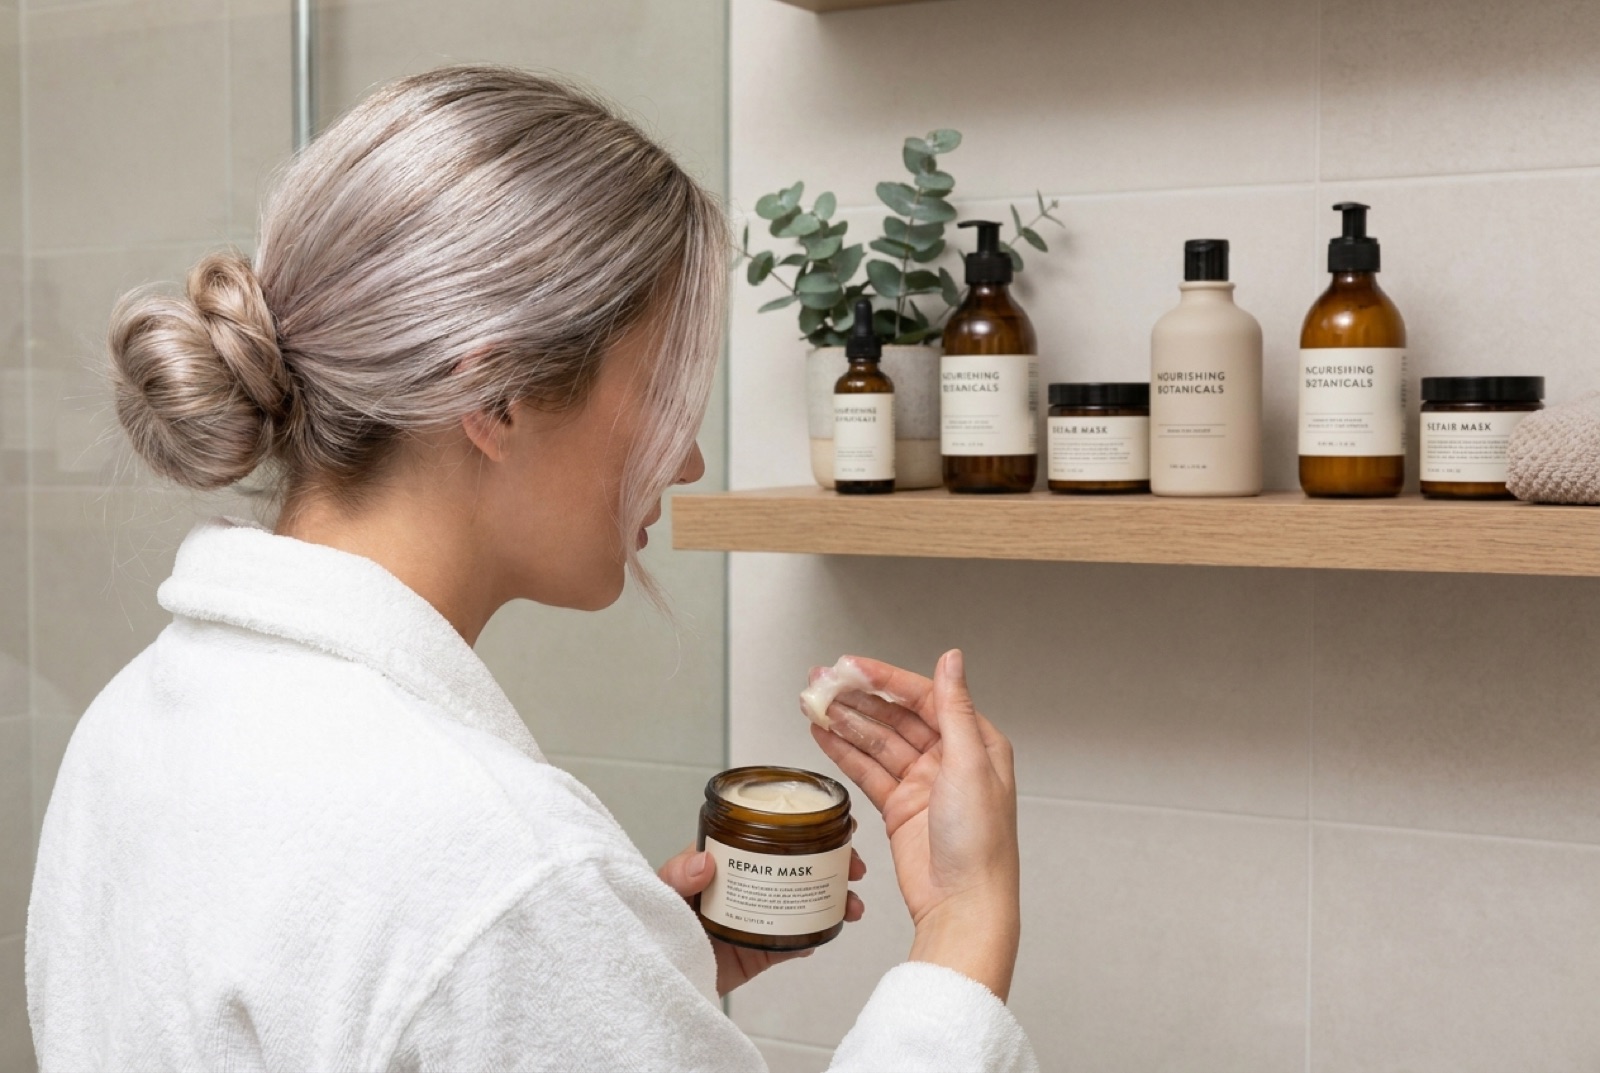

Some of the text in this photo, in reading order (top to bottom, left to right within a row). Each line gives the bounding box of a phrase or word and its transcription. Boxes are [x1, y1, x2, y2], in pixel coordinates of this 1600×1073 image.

[1157, 371, 1225, 381] NOURISHING
[1157, 384, 1224, 394] BOTANICALS
[728, 858, 813, 877] REPAIR MASK
